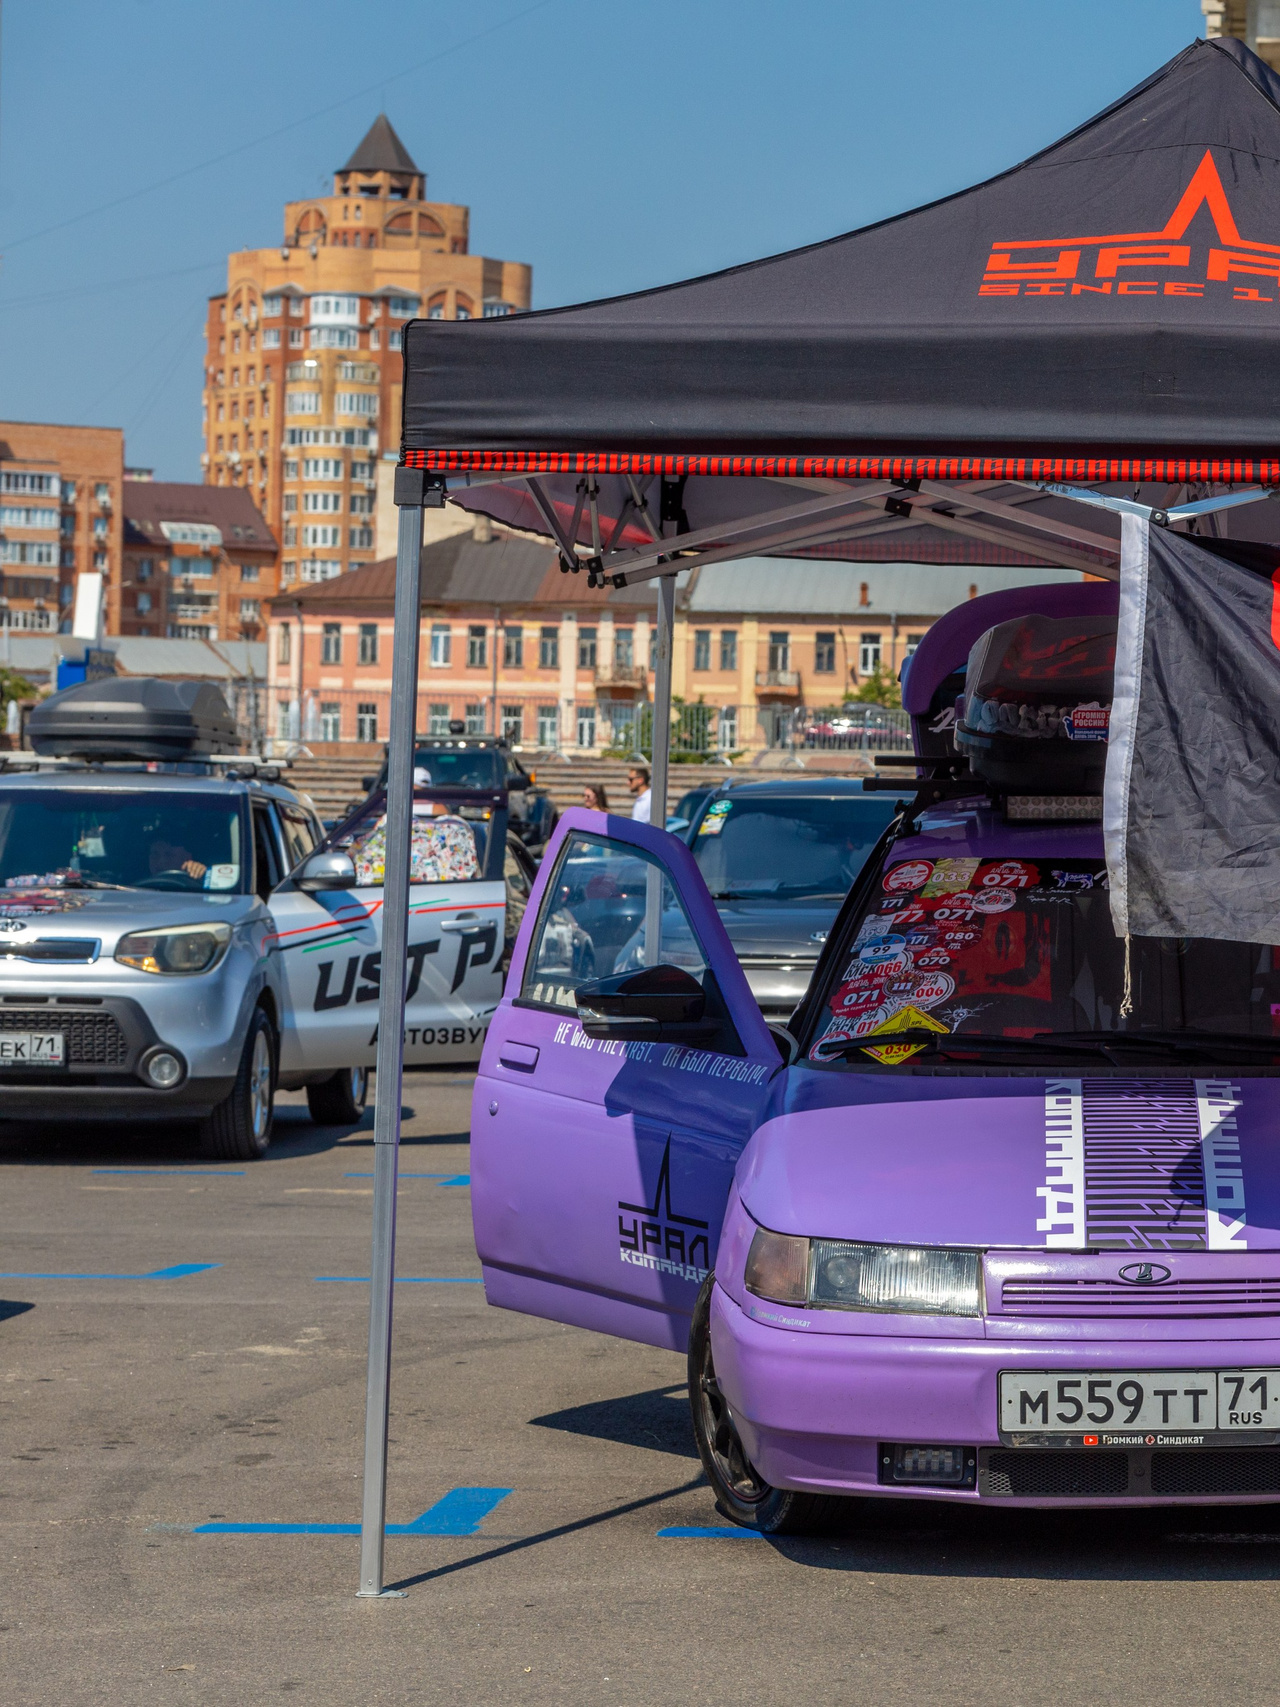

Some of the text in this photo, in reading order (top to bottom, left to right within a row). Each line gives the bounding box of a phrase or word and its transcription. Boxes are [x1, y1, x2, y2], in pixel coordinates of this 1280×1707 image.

[978, 281, 1204, 298] SINCE
[1074, 719, 1105, 727] РОССИЮ
[932, 872, 971, 883] 033
[982, 873, 1029, 887] 071
[881, 898, 905, 909] 171
[933, 908, 975, 921] 071
[910, 935, 929, 945] 171
[945, 932, 975, 940] 080
[872, 946, 892, 955] 99
[450, 925, 504, 995] P
[918, 956, 951, 966] 070
[843, 989, 880, 1006] 071
[916, 986, 944, 998] 006
[554, 1022, 572, 1045] HE
[856, 1020, 879, 1034] 011
[34, 1037, 55, 1052] 71
[662, 1047, 770, 1086] ОН БЫЛ ПЕРВЫМ.
[618, 1215, 709, 1270] УРАЛ
[1223, 1376, 1268, 1411] 71
[1229, 1411, 1263, 1425] RUS
[1102, 1434, 1204, 1445] Громкий Синдикат
